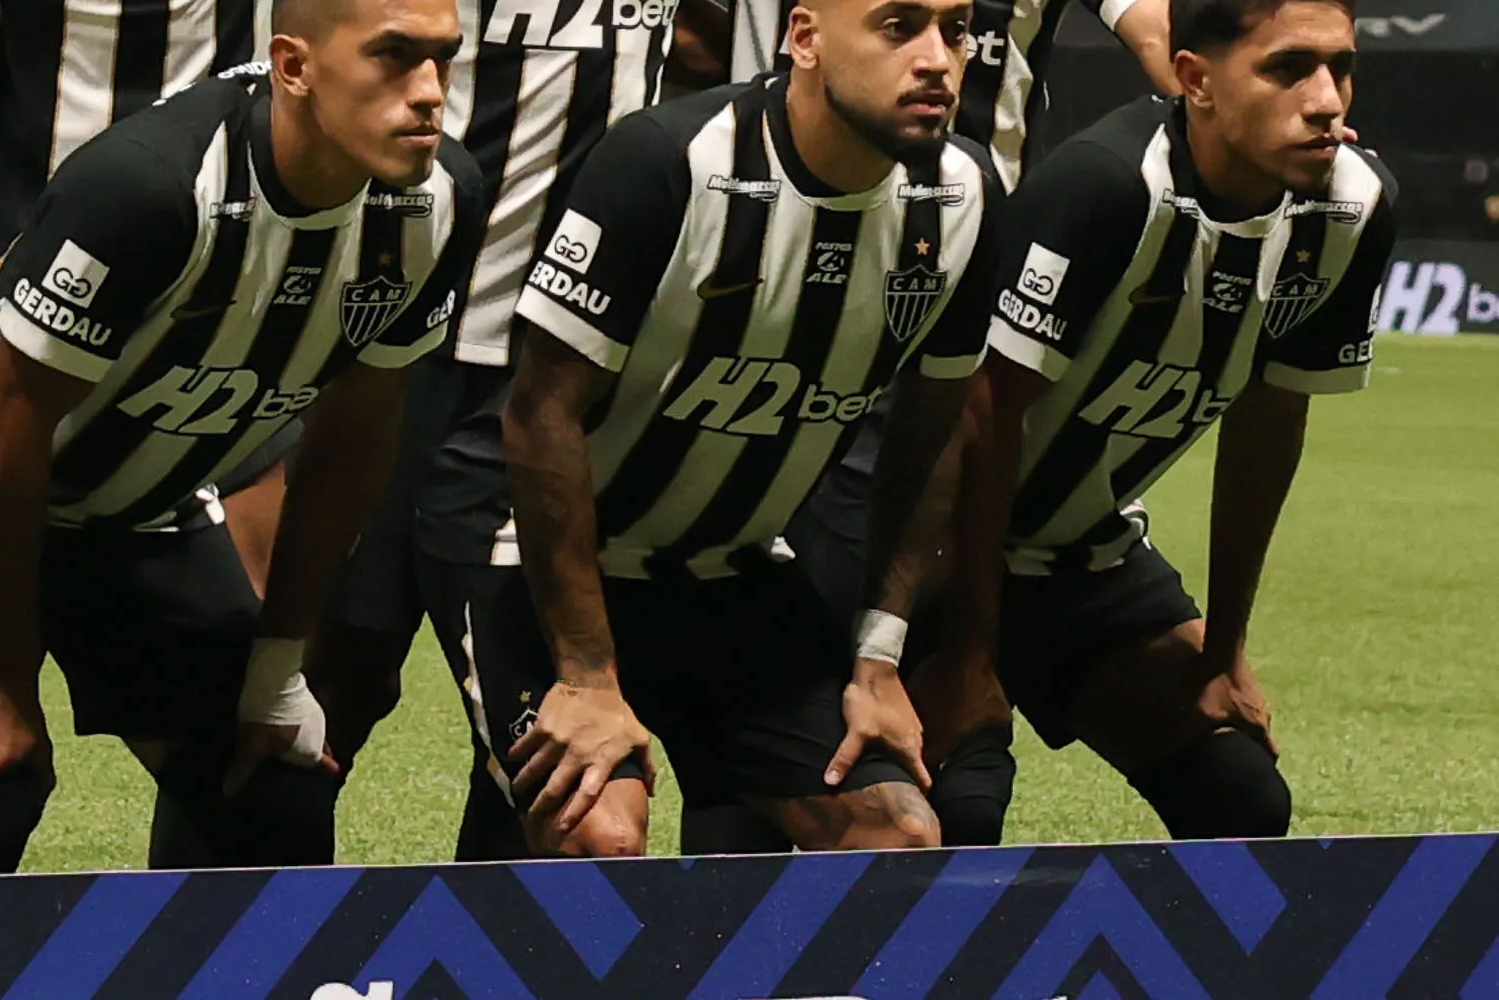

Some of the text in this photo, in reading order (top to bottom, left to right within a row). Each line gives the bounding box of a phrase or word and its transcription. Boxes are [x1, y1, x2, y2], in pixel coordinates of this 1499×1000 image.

[351, 288, 401, 301] CAM
[528, 261, 611, 316] ERDAU
[805, 273, 848, 284] ALE
[892, 277, 937, 291] CAM
[1272, 283, 1318, 297] CAM
[13, 277, 112, 347] GERDAU
[998, 288, 1068, 341] GERDAU
[1377, 261, 1499, 337] H2b
